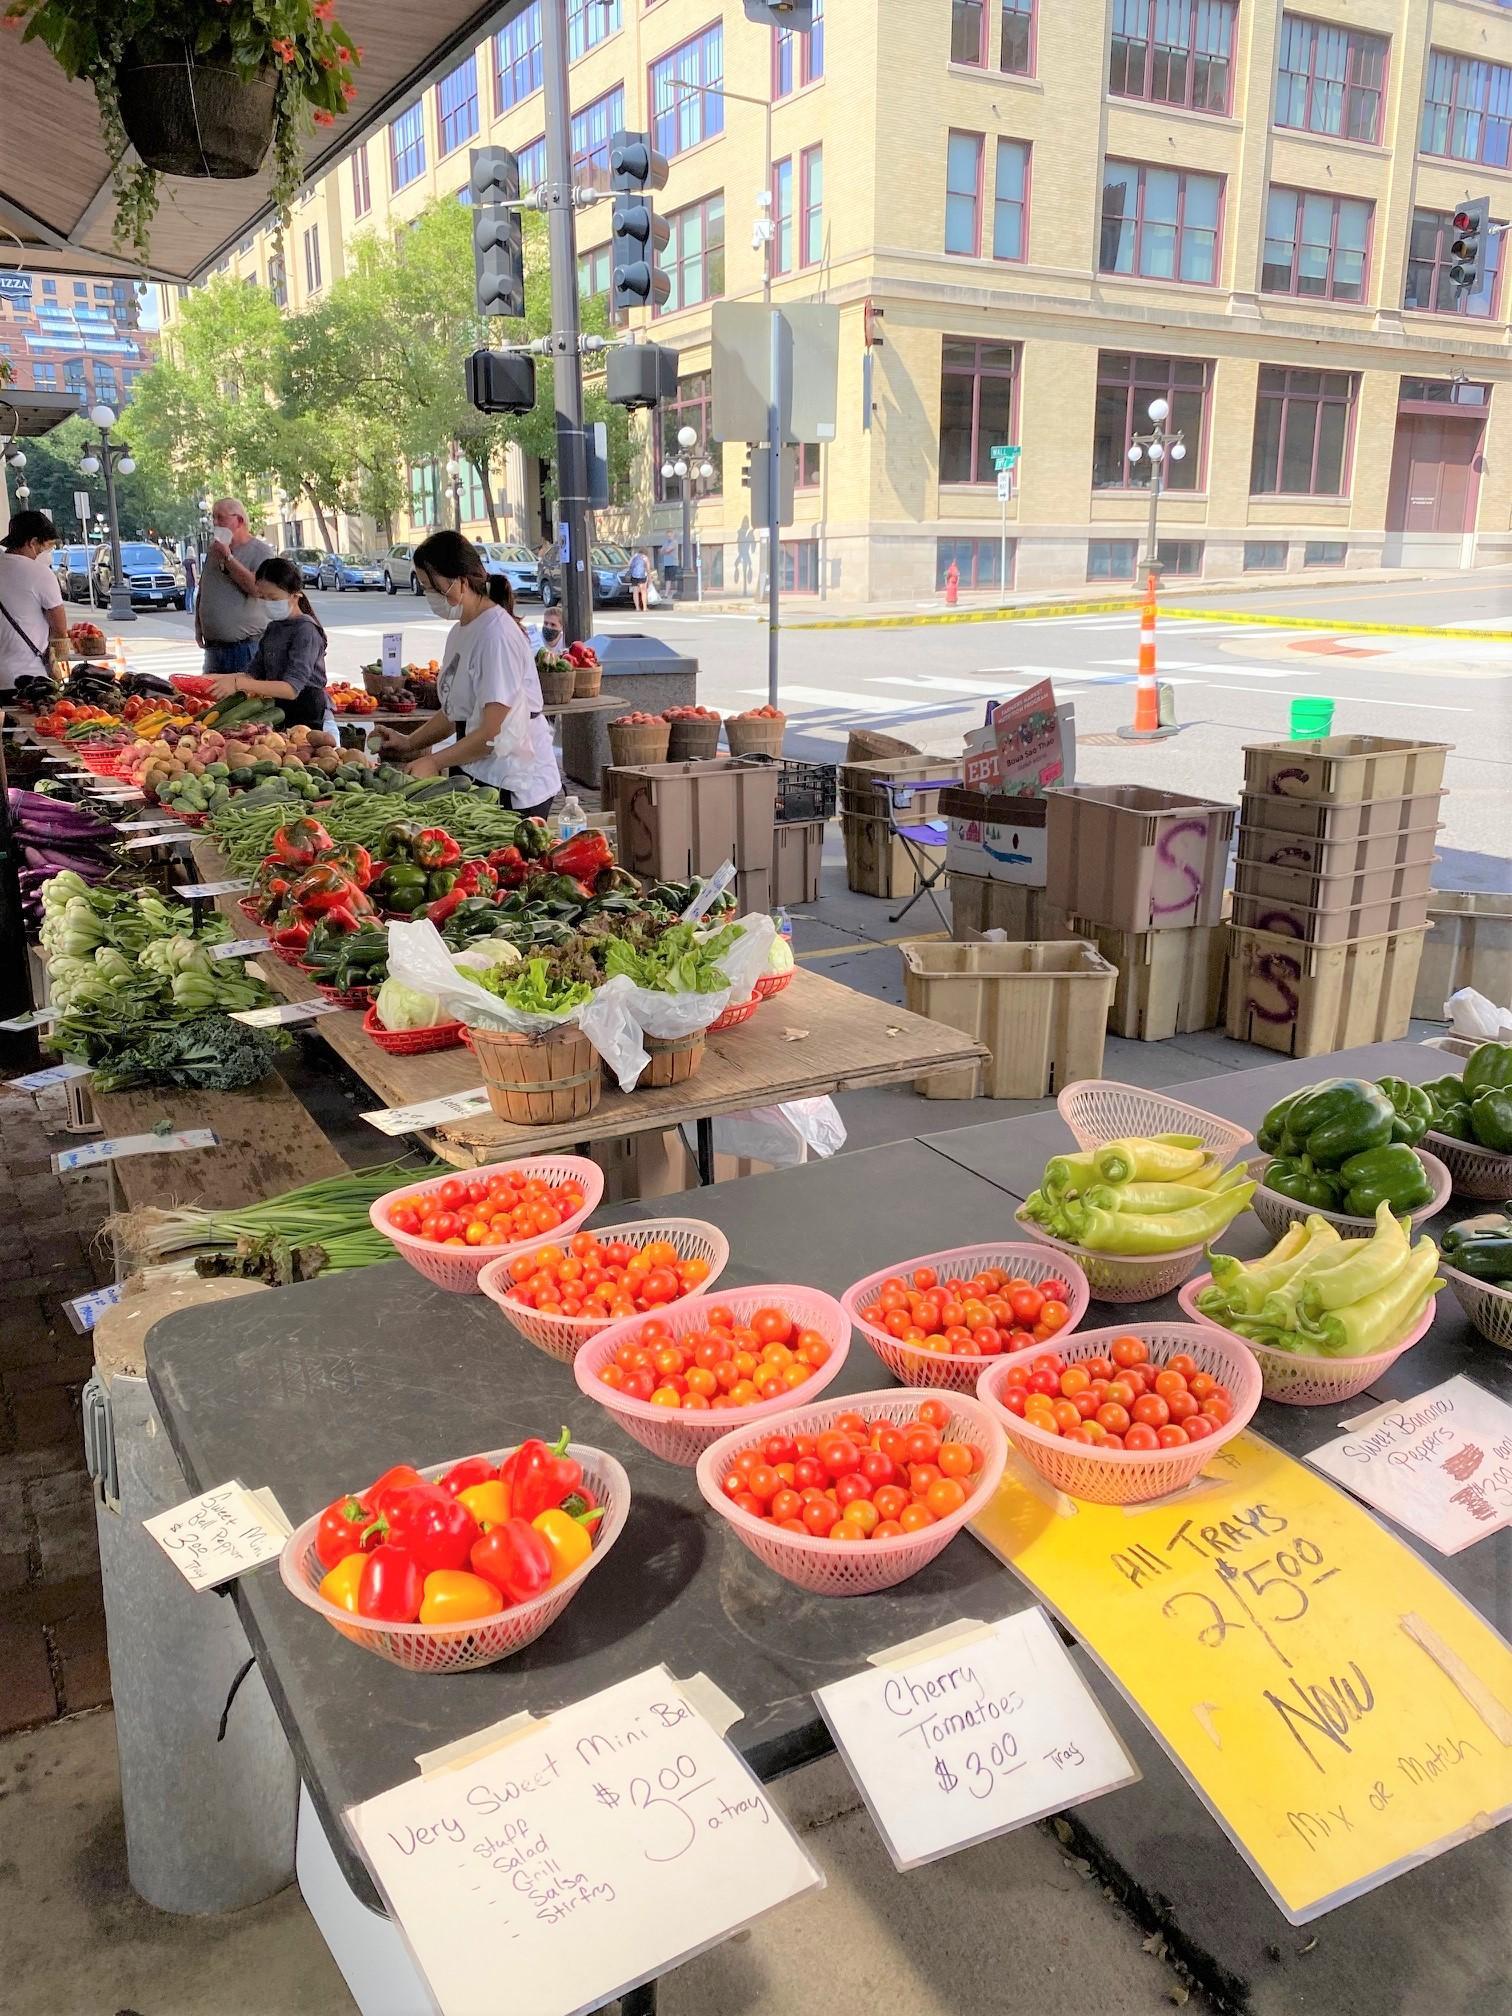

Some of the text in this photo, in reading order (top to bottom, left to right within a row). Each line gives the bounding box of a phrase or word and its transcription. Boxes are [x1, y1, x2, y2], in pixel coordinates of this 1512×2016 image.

[0, 278, 29, 290] IZZA
[967, 756, 1000, 783] EBT
[1149, 820, 1207, 914] S
[1342, 1399, 1455, 1463] Sweet Banana
[1387, 1426, 1455, 1473] Peppers
[1111, 1503, 1289, 1590] All TRAYS
[884, 1665, 985, 1717] Cherry
[897, 1690, 1025, 1749] Tomatoes
[387, 1817, 467, 1857] Very
[465, 1752, 561, 1816] Sweet
[575, 1716, 650, 1767] Mini
[1286, 1804, 1355, 1853] Mix
[1396, 1736, 1483, 1786] Match
[511, 1858, 562, 1893] Grill
